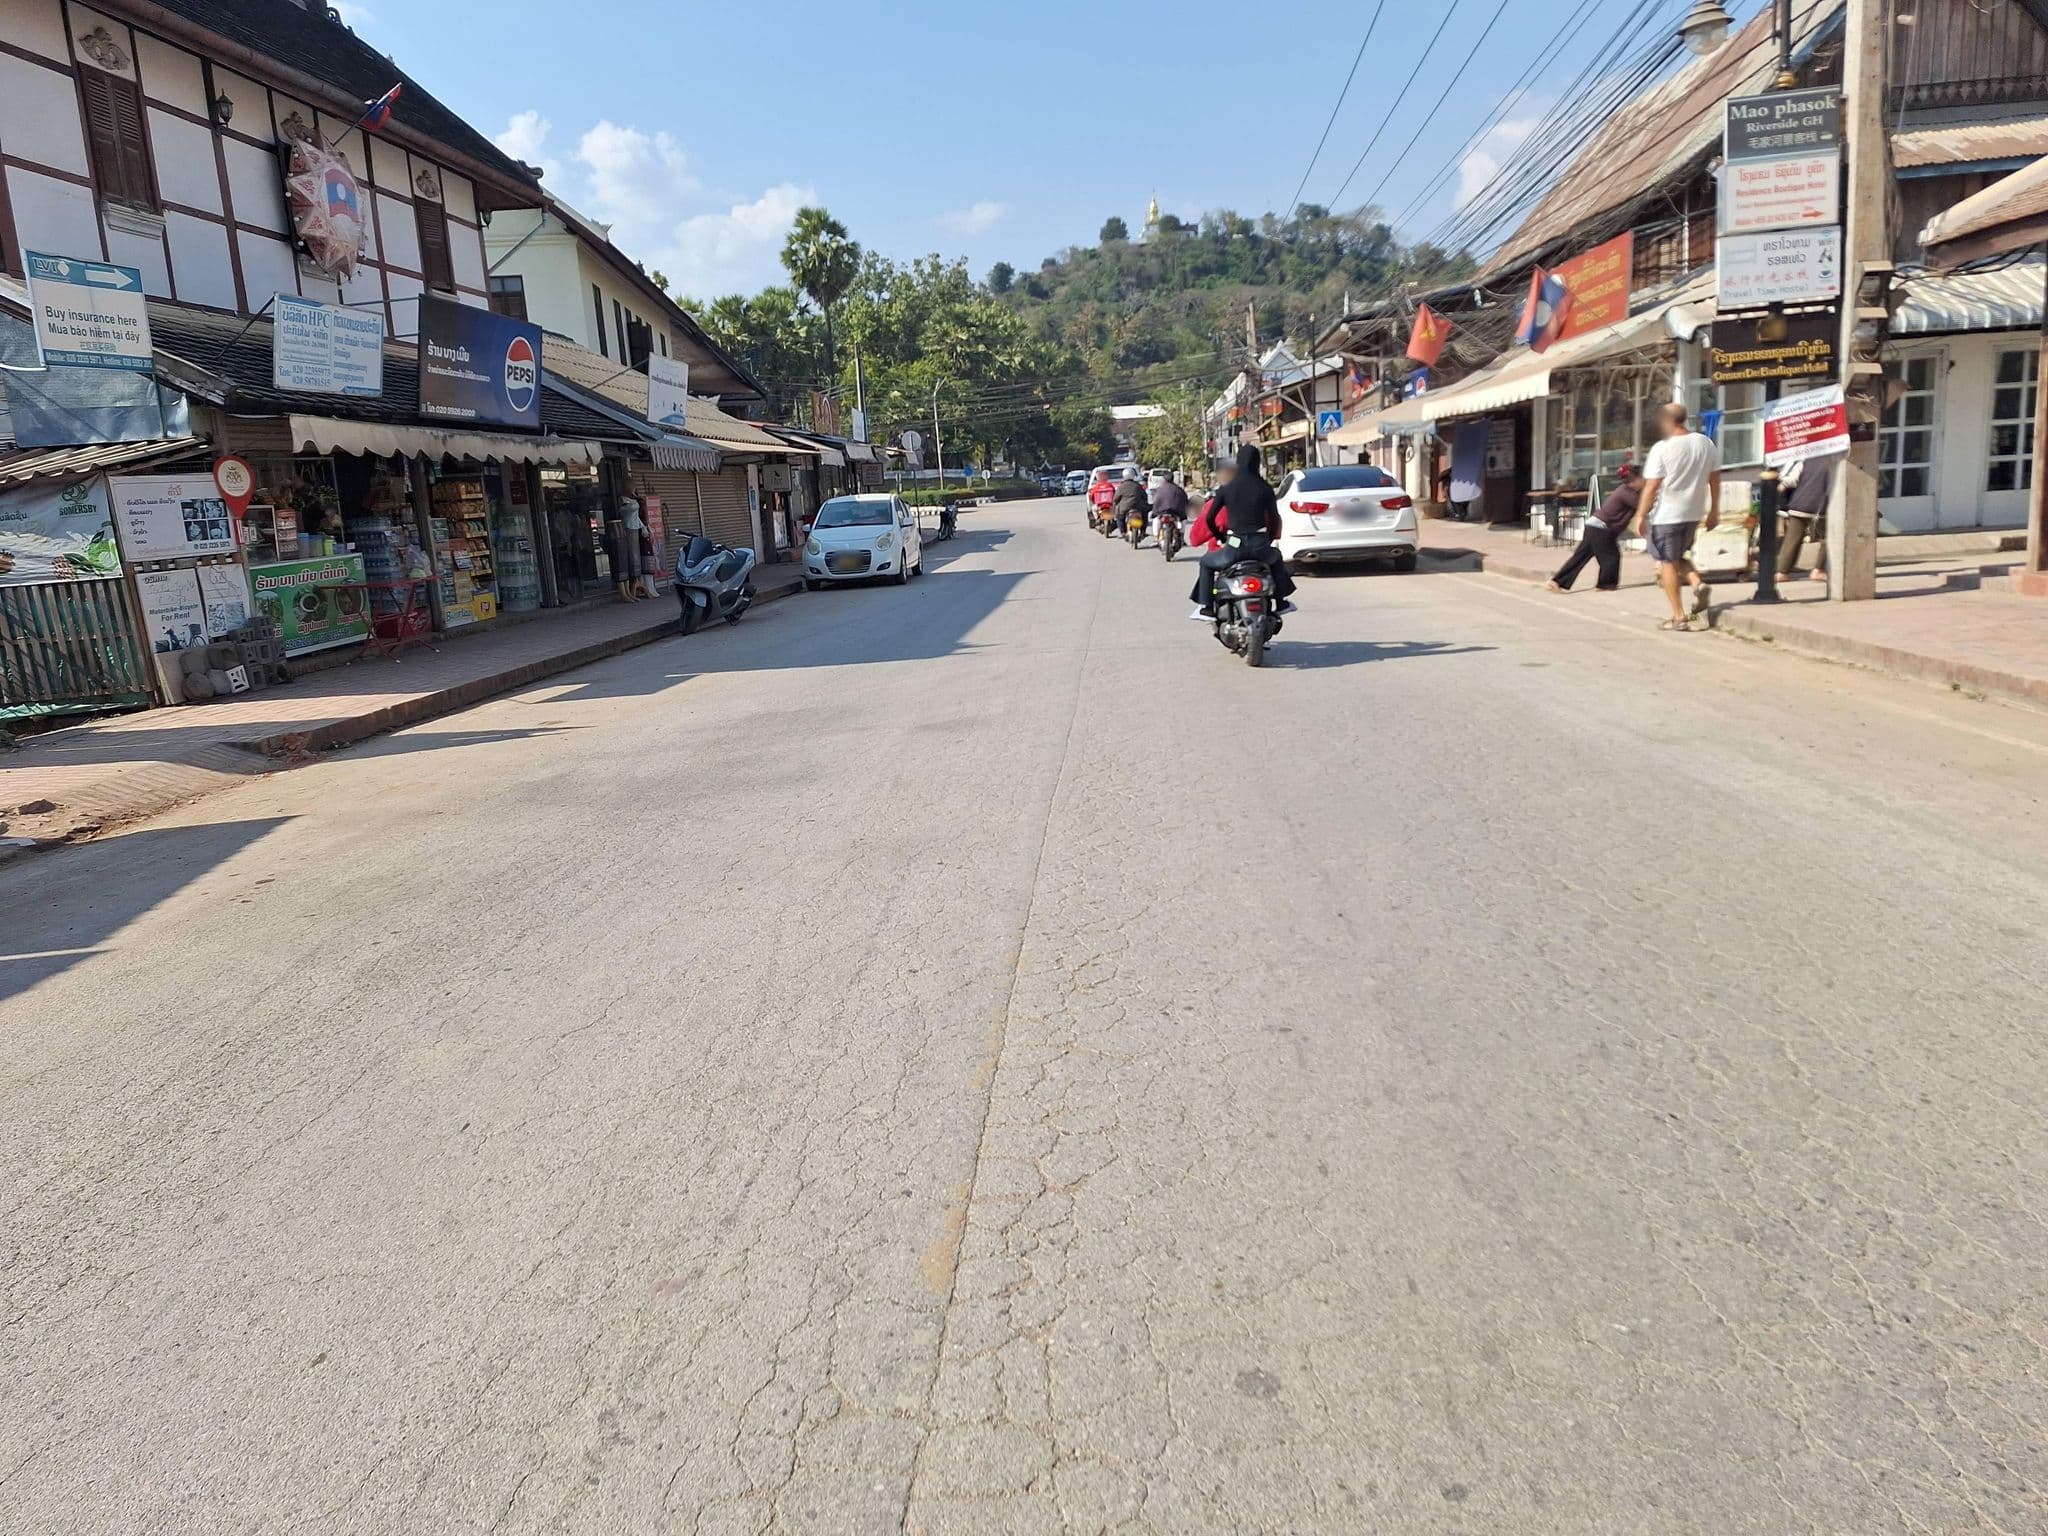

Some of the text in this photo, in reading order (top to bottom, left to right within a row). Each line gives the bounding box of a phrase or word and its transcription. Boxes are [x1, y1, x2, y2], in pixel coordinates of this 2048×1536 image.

[1730, 95, 1836, 119] Mao phasok
[1746, 115, 1823, 132] Riverside GH
[45, 305, 137, 327] Buy insurance here
[309, 310, 330, 328] HPC
[47, 322, 68, 335] Mua
[507, 365, 534, 384] PEPSI
[1804, 361, 1828, 373] Hotel
[59, 504, 97, 516] SOMERSBY
[161, 612, 190, 622] For Rent
